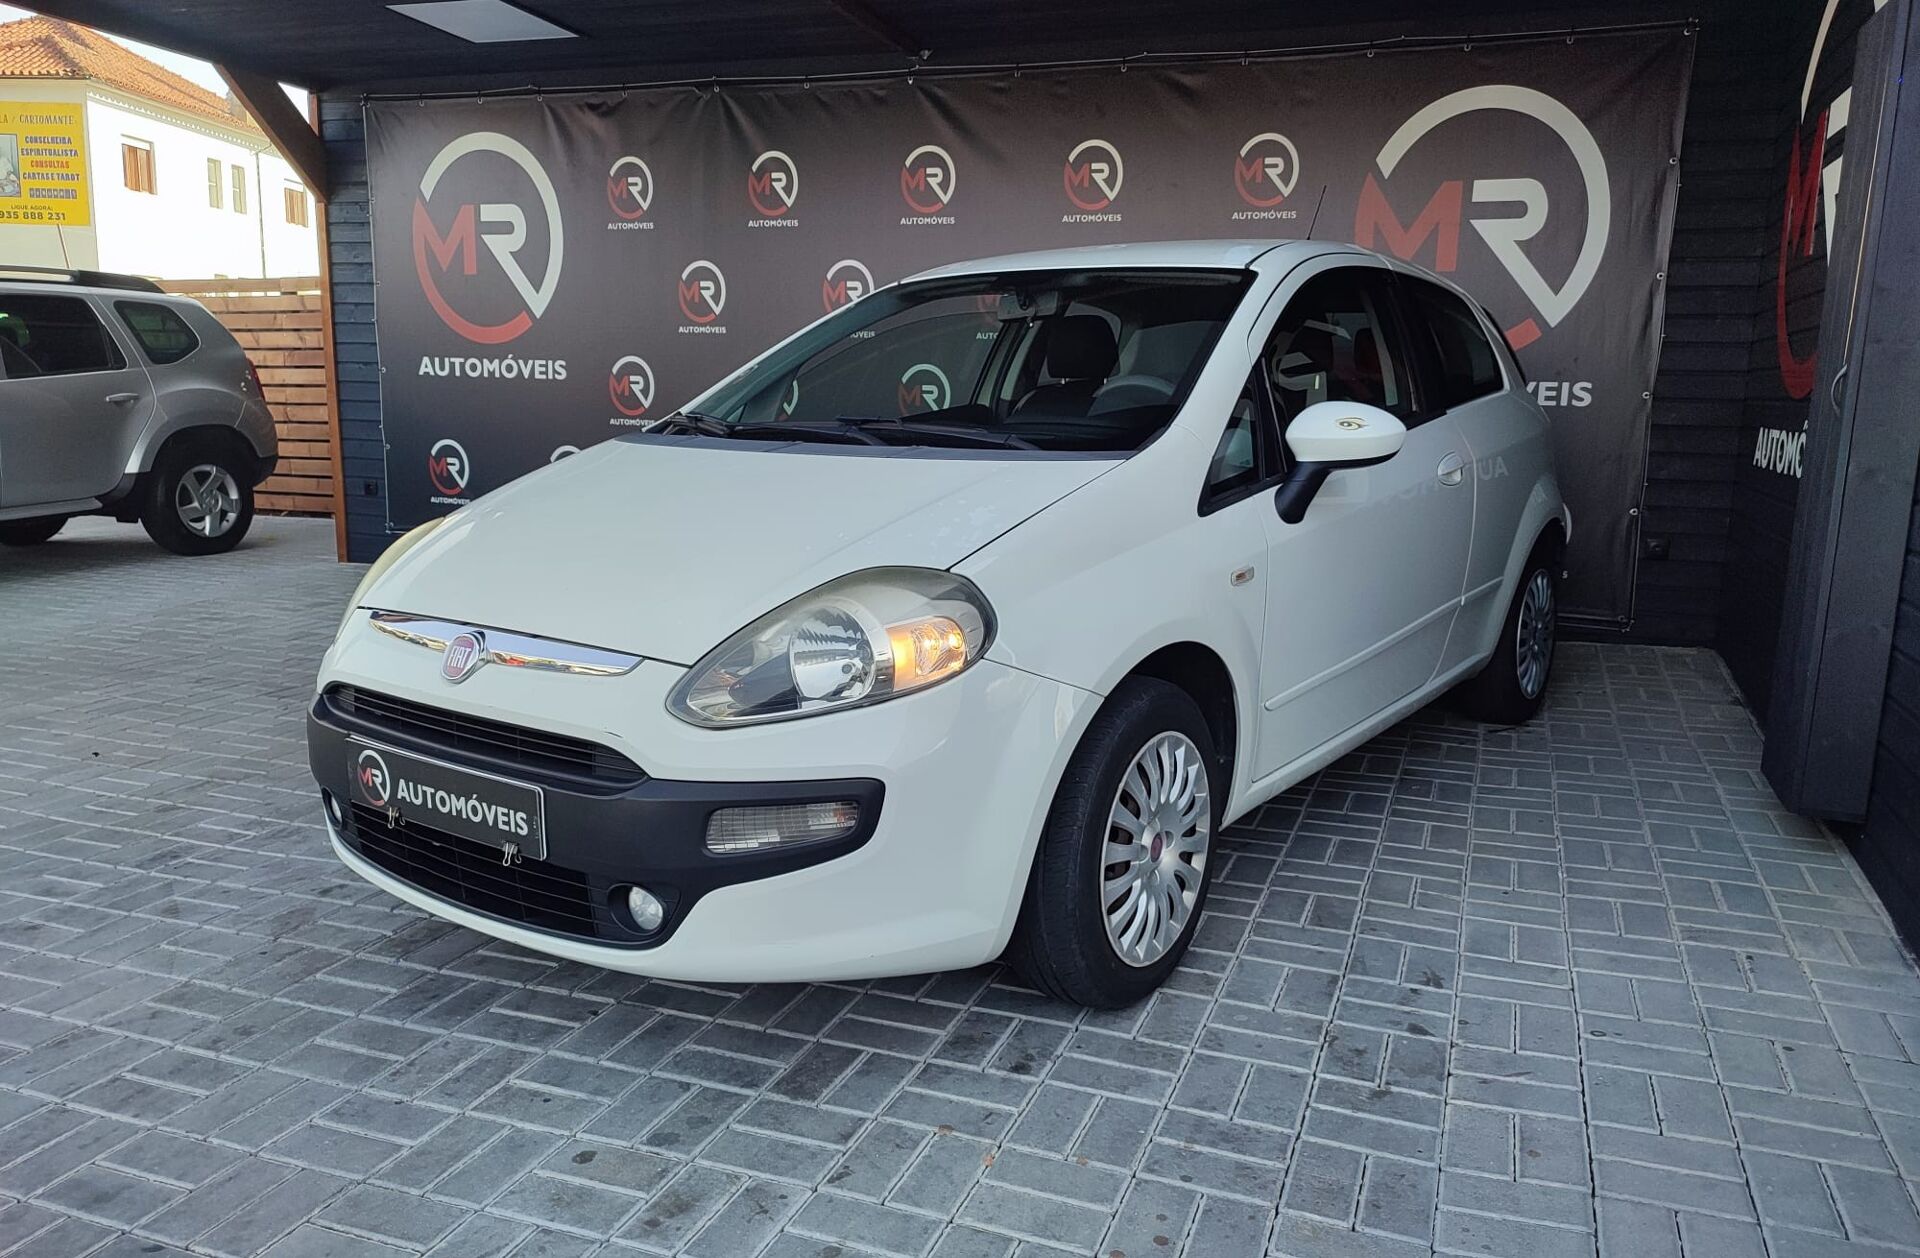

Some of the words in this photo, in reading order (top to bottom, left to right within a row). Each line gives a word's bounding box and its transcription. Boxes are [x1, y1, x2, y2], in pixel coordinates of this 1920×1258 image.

[20, 114, 73, 125] CARTOMANTE
[22, 211, 44, 220] 888
[47, 212, 66, 221] 231
[1061, 213, 1123, 223] AUTOMÓVEIS
[1231, 210, 1297, 221] AUTOMÓVEIS
[607, 221, 655, 230] AUTOMÓVEIS
[747, 219, 799, 228] AUTOMÓVEIS
[900, 216, 956, 226] AUTOMÓVEIS
[678, 325, 727, 334] AUTOMÓVEIS
[418, 353, 568, 381] AUTOMÓVEIS
[447, 645, 472, 669] FIAT
[397, 778, 529, 836] AUTOMÓVEIS
